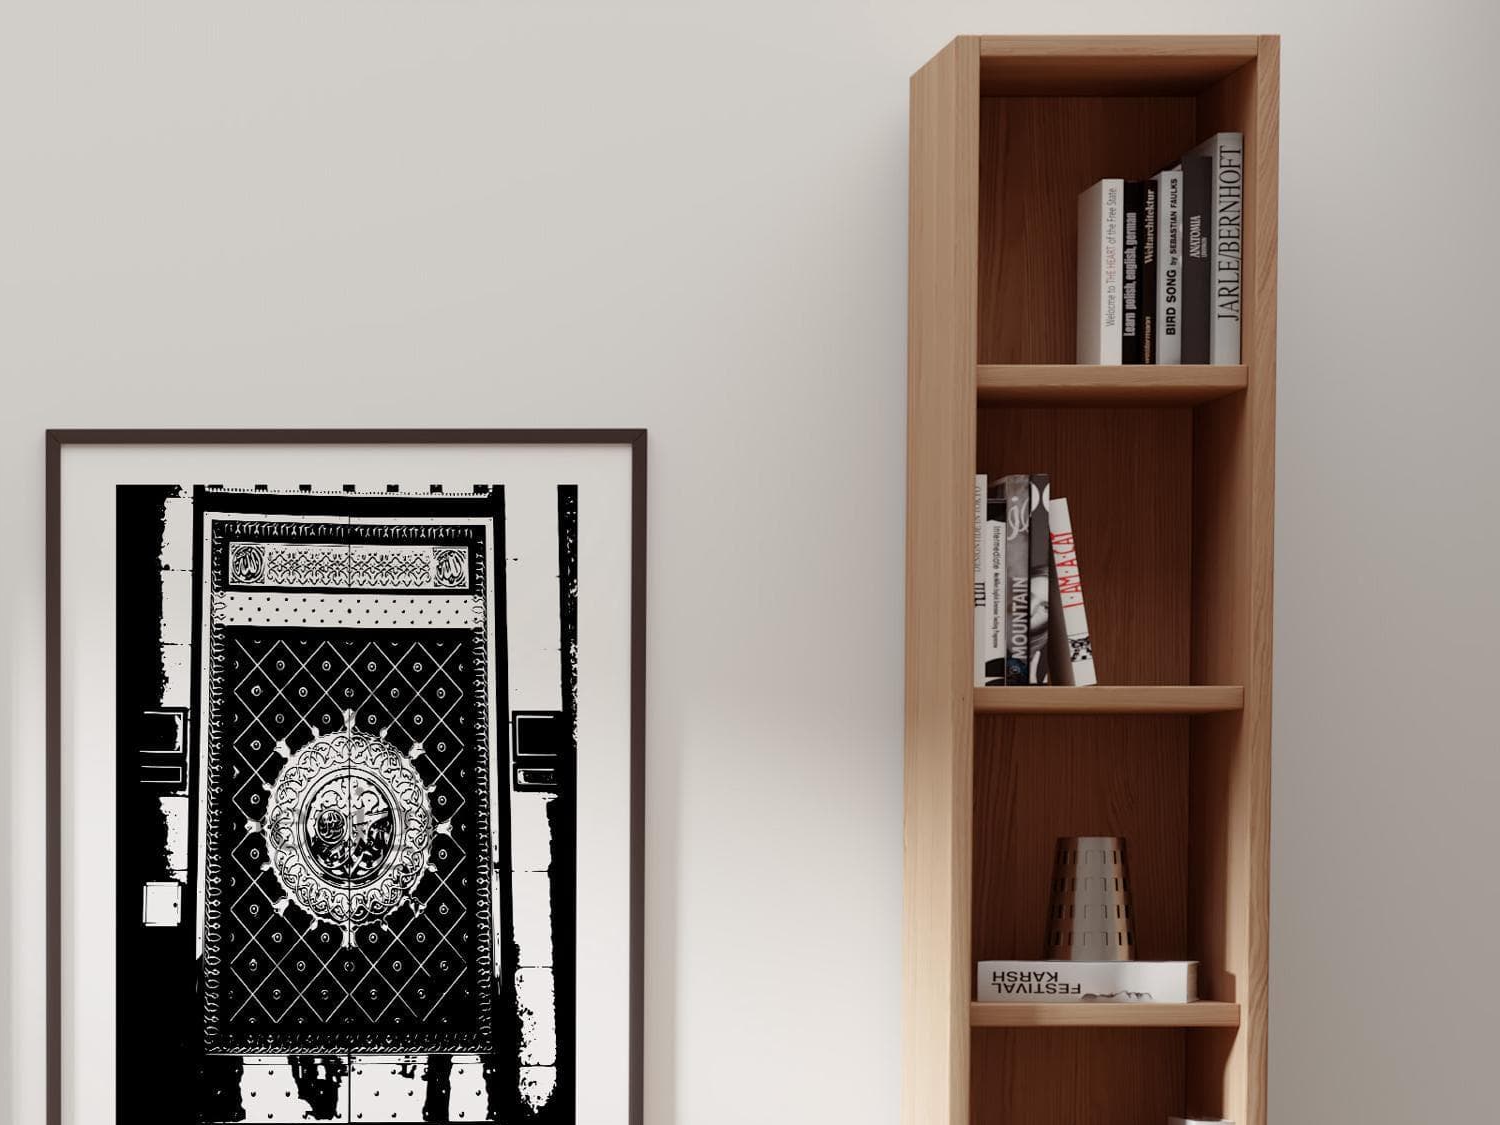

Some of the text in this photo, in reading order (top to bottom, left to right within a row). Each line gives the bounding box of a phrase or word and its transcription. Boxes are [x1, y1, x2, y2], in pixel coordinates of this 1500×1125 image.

[1107, 207, 1117, 223] Free
[1144, 189, 1156, 264] Weltarchitektur
[1190, 215, 1201, 258] ANATOMIA
[1217, 145, 1242, 322] JARLE/BERNHOFT
[1106, 245, 1117, 269] HEART
[1165, 178, 1178, 335] BIRD SONG by SEBASTIAN FAULKS
[1123, 312, 1136, 337] Learn
[1011, 576, 1029, 660] MOUNTAIN
[991, 982, 1082, 995] FESTIVAL
[992, 970, 1059, 983] KARSH
